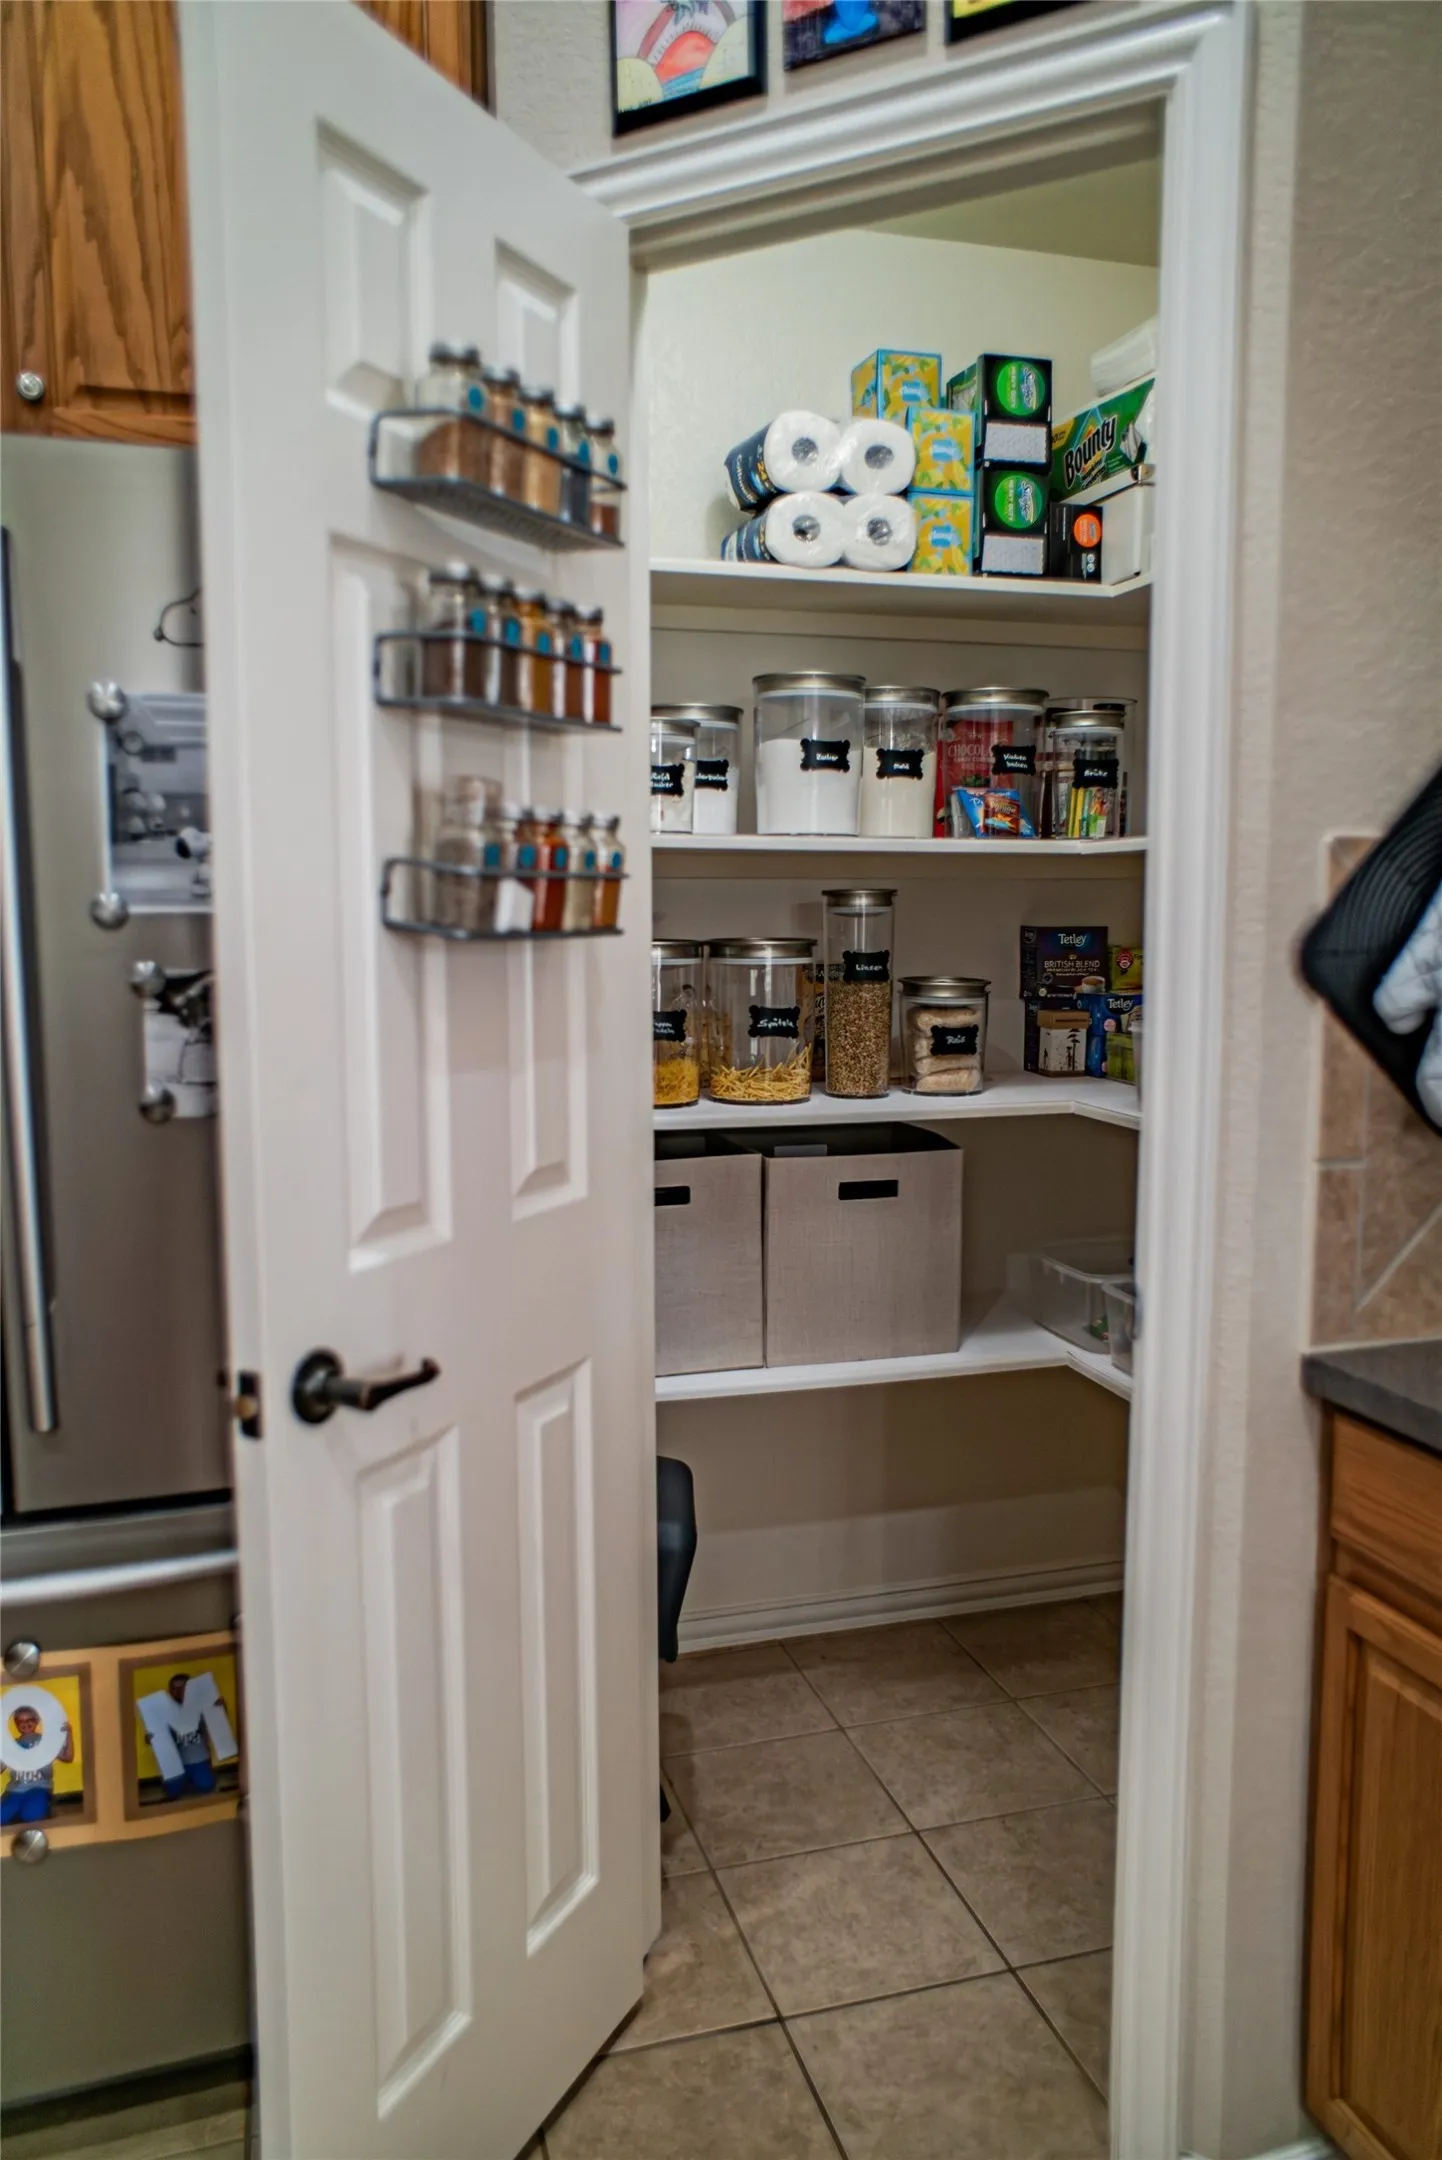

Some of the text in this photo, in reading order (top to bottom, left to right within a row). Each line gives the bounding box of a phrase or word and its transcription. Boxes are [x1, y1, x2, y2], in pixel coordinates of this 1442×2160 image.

[1063, 415, 1117, 489] Bounty
[1058, 934, 1088, 946] Tetley
[855, 963, 883, 972] Linsen
[1044, 960, 1100, 968] BRITISH BLEND
[1106, 998, 1134, 1011] Tetley
[945, 1034, 966, 1046] Reis
